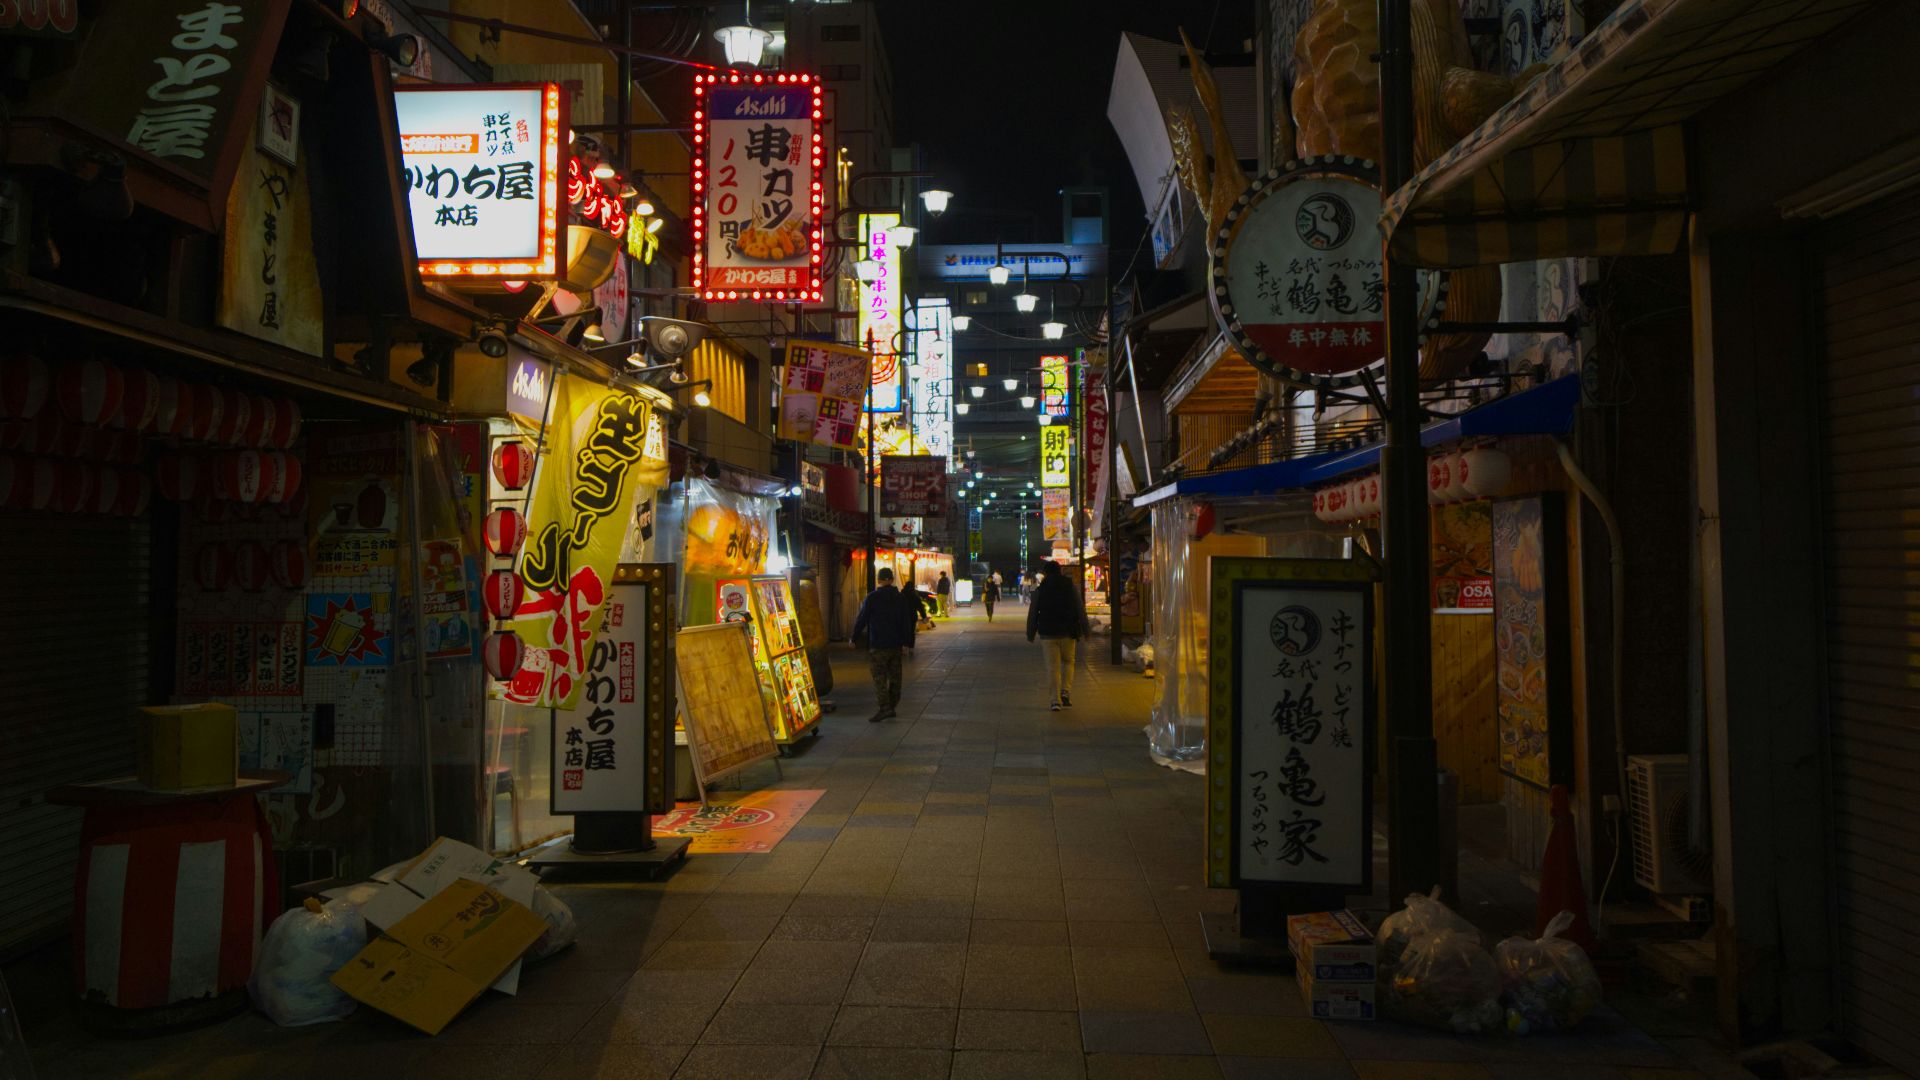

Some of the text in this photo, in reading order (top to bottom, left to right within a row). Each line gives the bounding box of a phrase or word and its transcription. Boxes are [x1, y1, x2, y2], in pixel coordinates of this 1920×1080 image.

[734, 95, 787, 116] Asahi
[482, 114, 499, 157] 串カツ
[744, 122, 794, 230] 串カツ
[433, 203, 479, 227] 本店
[260, 168, 290, 331] やまと屋
[725, 268, 788, 285] かわち屋
[1286, 257, 1322, 275] 名代
[1328, 258, 1384, 272] つるかめ
[1287, 326, 1374, 349] 年中無休
[512, 361, 545, 404] Asahi
[885, 474, 942, 491] ビリーズ
[898, 491, 929, 499] SHOP
[1462, 586, 1493, 598] OSA
[1330, 608, 1355, 674] 串かつ
[1272, 658, 1322, 681] 名代
[585, 638, 618, 770] かわち屋
[564, 726, 584, 767] 本店
[1271, 682, 1330, 866] 鶴亀家
[1249, 769, 1270, 856] つるかめや
